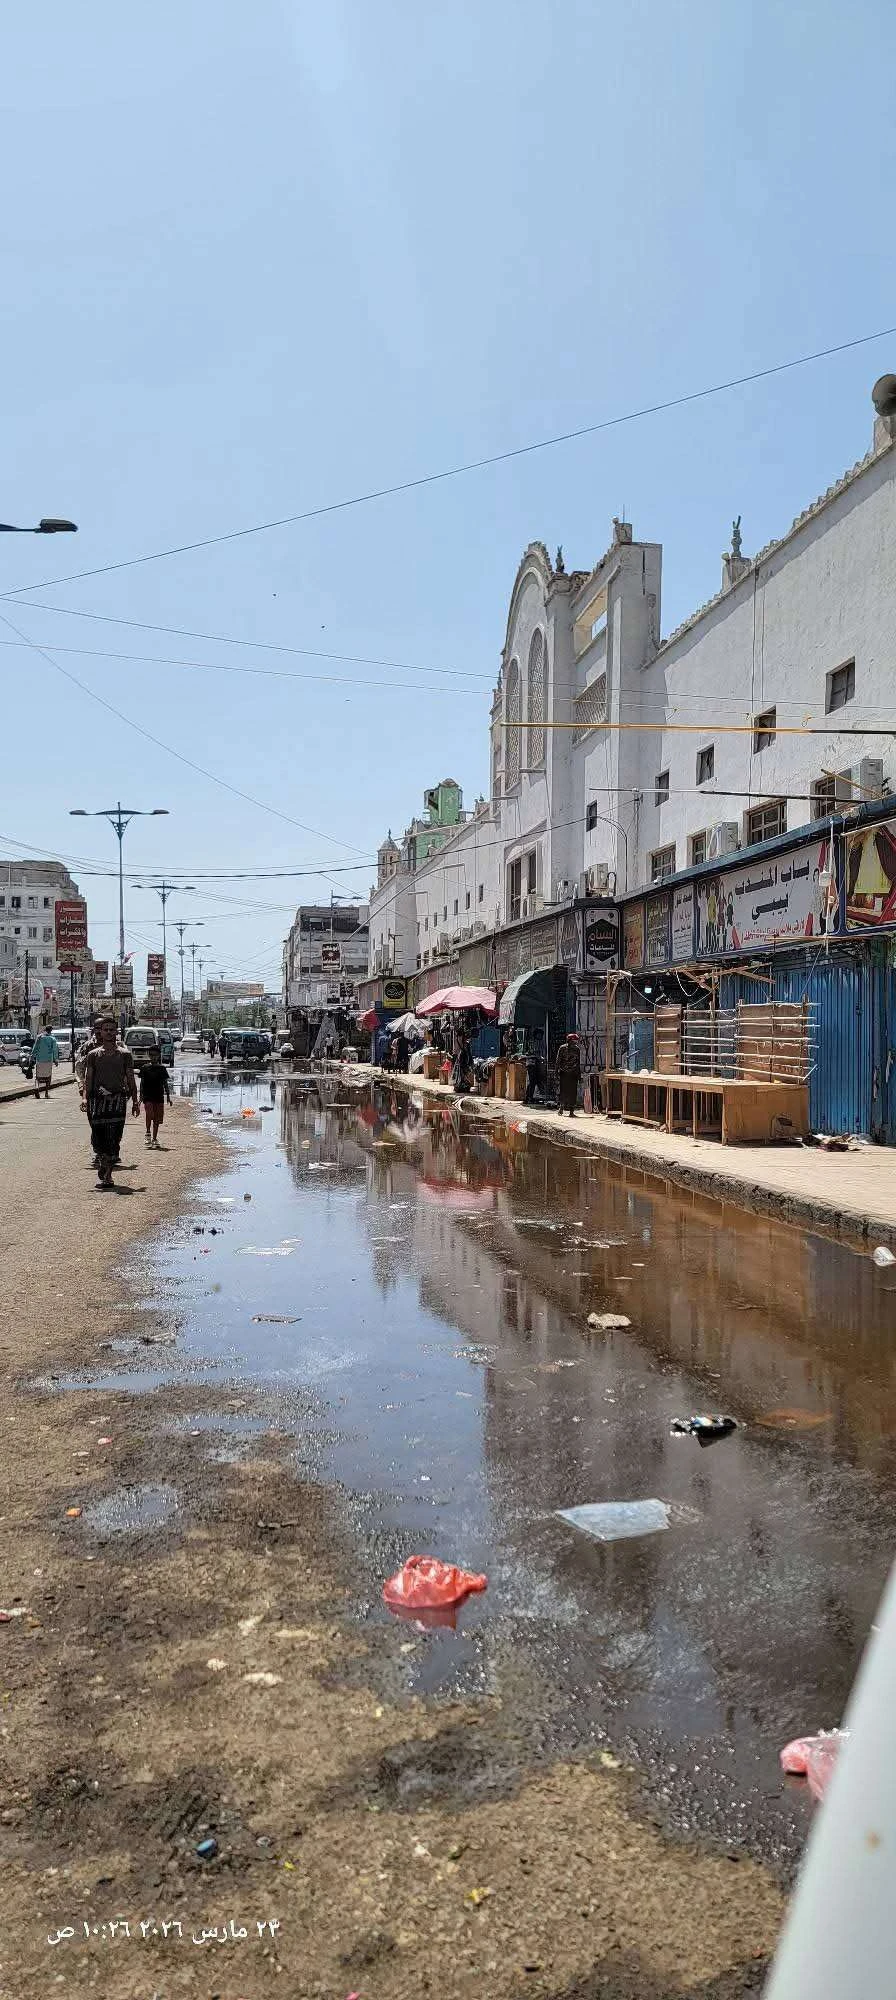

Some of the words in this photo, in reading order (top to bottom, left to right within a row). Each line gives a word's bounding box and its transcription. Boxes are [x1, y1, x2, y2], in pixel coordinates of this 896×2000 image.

[735, 864, 778, 900] المندب
[781, 859, 810, 887] باب
[751, 892, 789, 925] بيبي
